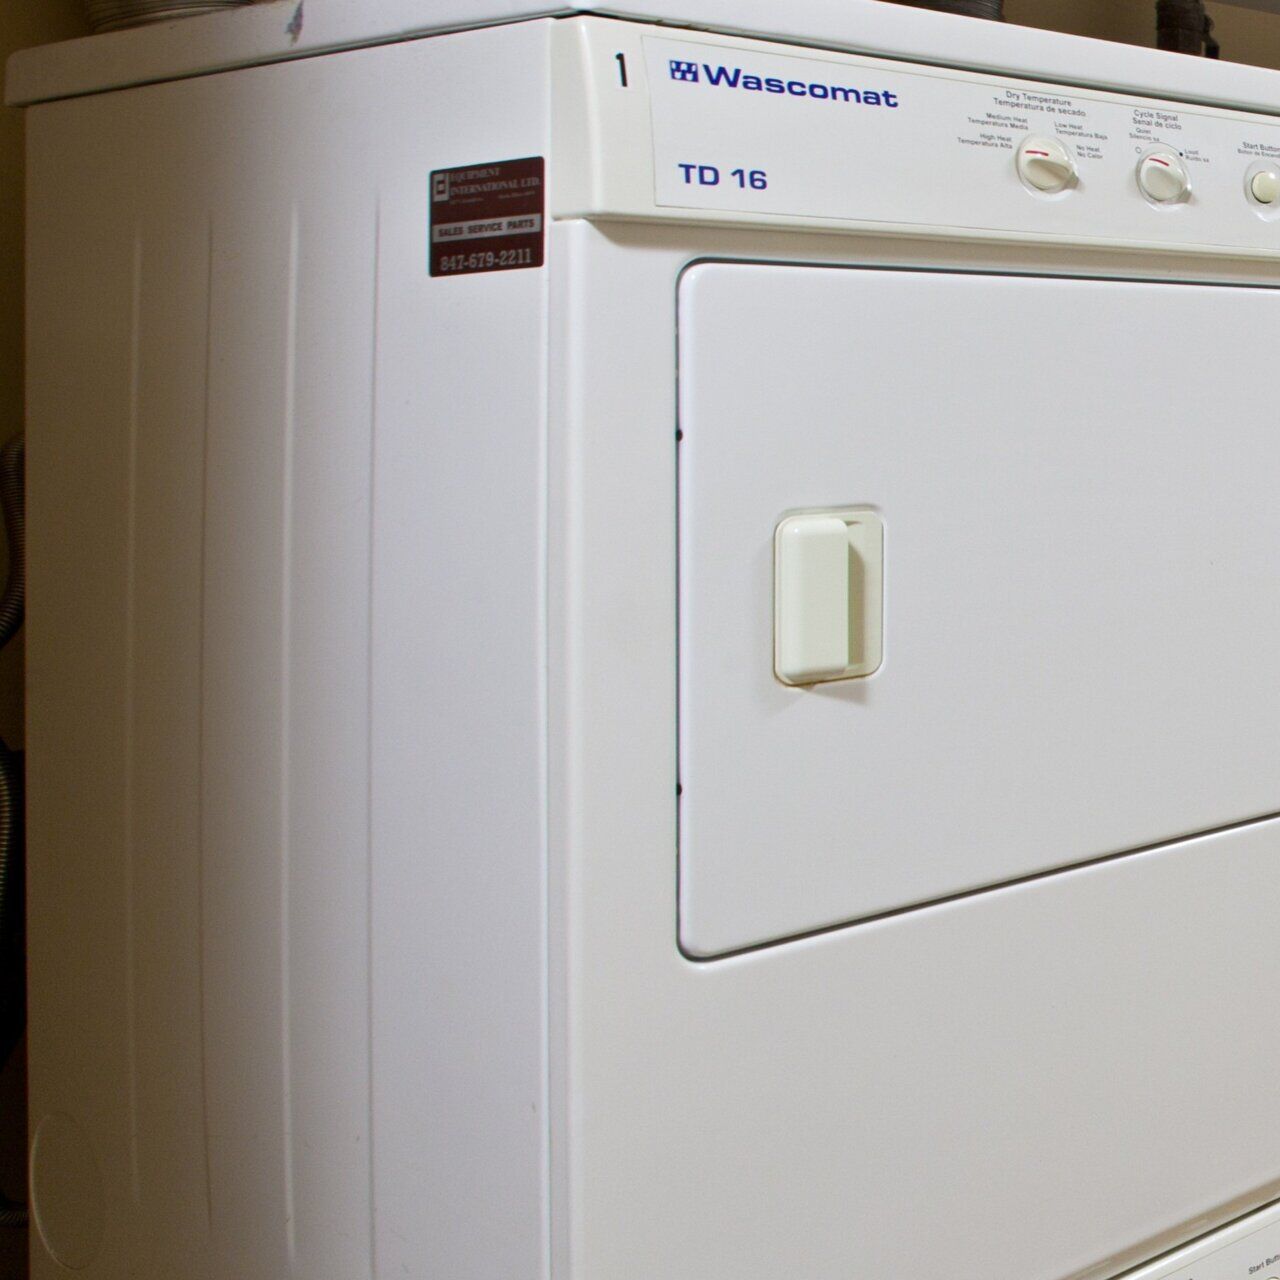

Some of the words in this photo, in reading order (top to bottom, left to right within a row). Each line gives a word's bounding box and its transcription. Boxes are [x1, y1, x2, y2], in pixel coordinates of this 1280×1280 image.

[616, 53, 627, 87] 1
[703, 64, 899, 108] Wascomat
[994, 98, 1044, 111] Temperatura
[1047, 105, 1055, 113] de
[1058, 107, 1086, 117] secado
[1006, 91, 1020, 100] Dry
[1022, 93, 1072, 106] Temperature
[1134, 110, 1153, 119] Cycle
[1156, 113, 1178, 122] Signal
[1243, 142, 1259, 150] Start
[1260, 144, 1280, 152] Button
[678, 163, 720, 186] TD
[731, 169, 767, 190] 16
[439, 227, 463, 237] SALES
[468, 222, 502, 233] SERVICE
[507, 219, 535, 229] PARTS
[441, 248, 531, 271] 847-679-2211
[1249, 1261, 1264, 1275] Start
